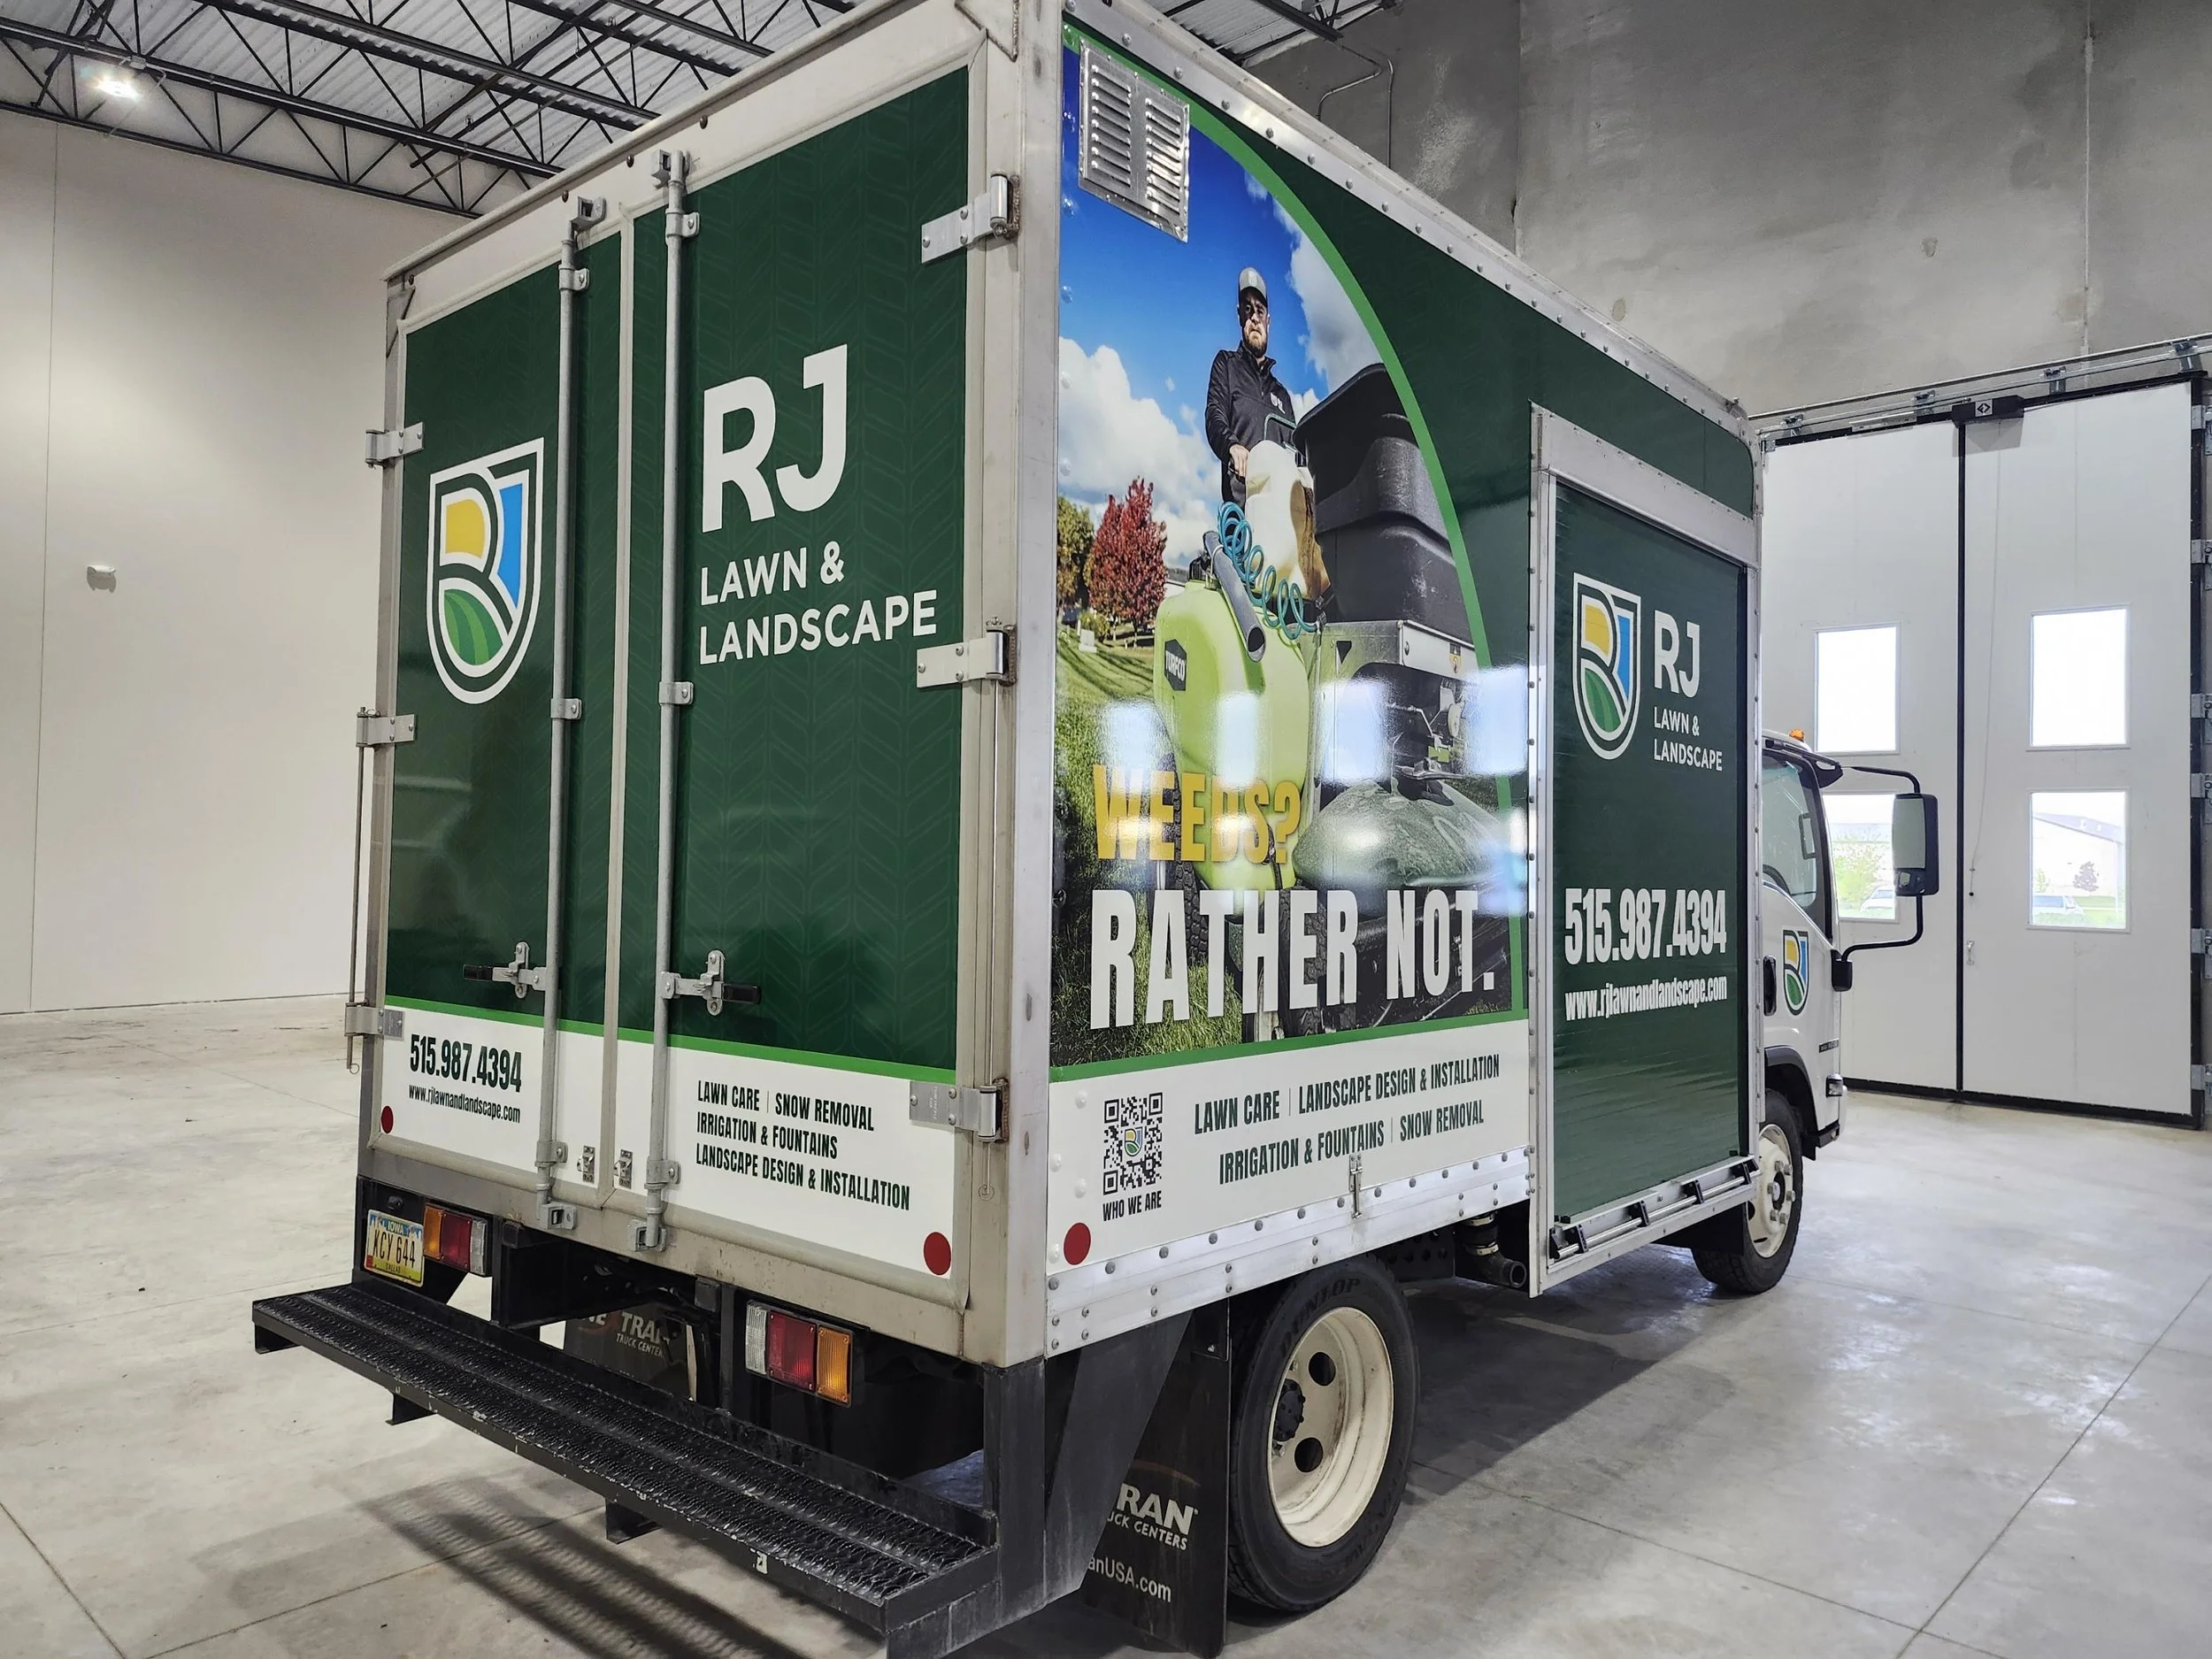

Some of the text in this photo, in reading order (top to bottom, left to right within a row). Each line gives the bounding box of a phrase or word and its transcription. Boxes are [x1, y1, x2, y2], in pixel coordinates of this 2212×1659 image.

[702, 343, 849, 534] RJ
[701, 541, 844, 606] LAWN &
[700, 589, 938, 665] LANDSCAPE
[1165, 649, 1186, 681] TURFCO
[1654, 610, 1701, 698] RJ
[1654, 706, 1700, 737] LAWN &
[1654, 738, 1723, 772] LANDSCAPE
[1093, 764, 1301, 864] WEEDS?
[1564, 887, 1727, 965] 515.987.4394
[1090, 889, 1494, 1030] RATHER NOT.
[1565, 976, 1727, 1021] www.rjlawnandlandscape.com
[410, 1033, 522, 1093] 515.987.4394
[409, 1084, 521, 1124] www.rjlawnandlandscape.com
[697, 1079, 874, 1132] LAWN CARE SNOW REMOVAL
[1194, 1054, 1500, 1135] LAWN CARE LANDSCAPE DESIGN & INSTALLATION
[697, 1111, 838, 1159] IRRIGATION & FOUNTAINS
[1219, 1100, 1484, 1186] IRRIGATION & FOUNTAINS SNOW REMOVAL
[696, 1142, 910, 1210] LANDSCAPE DESIGN & INSTALLATION
[388, 1220, 404, 1235] IOWA
[1102, 1190, 1162, 1222] WHO WE ARE
[396, 1236, 415, 1269] 644
[616, 1333, 637, 1349] TRUCK
[1117, 1483, 1195, 1535] RAN
[1133, 1521, 1188, 1551] CENTERS
[1088, 1556, 1172, 1602] anUSA.com
